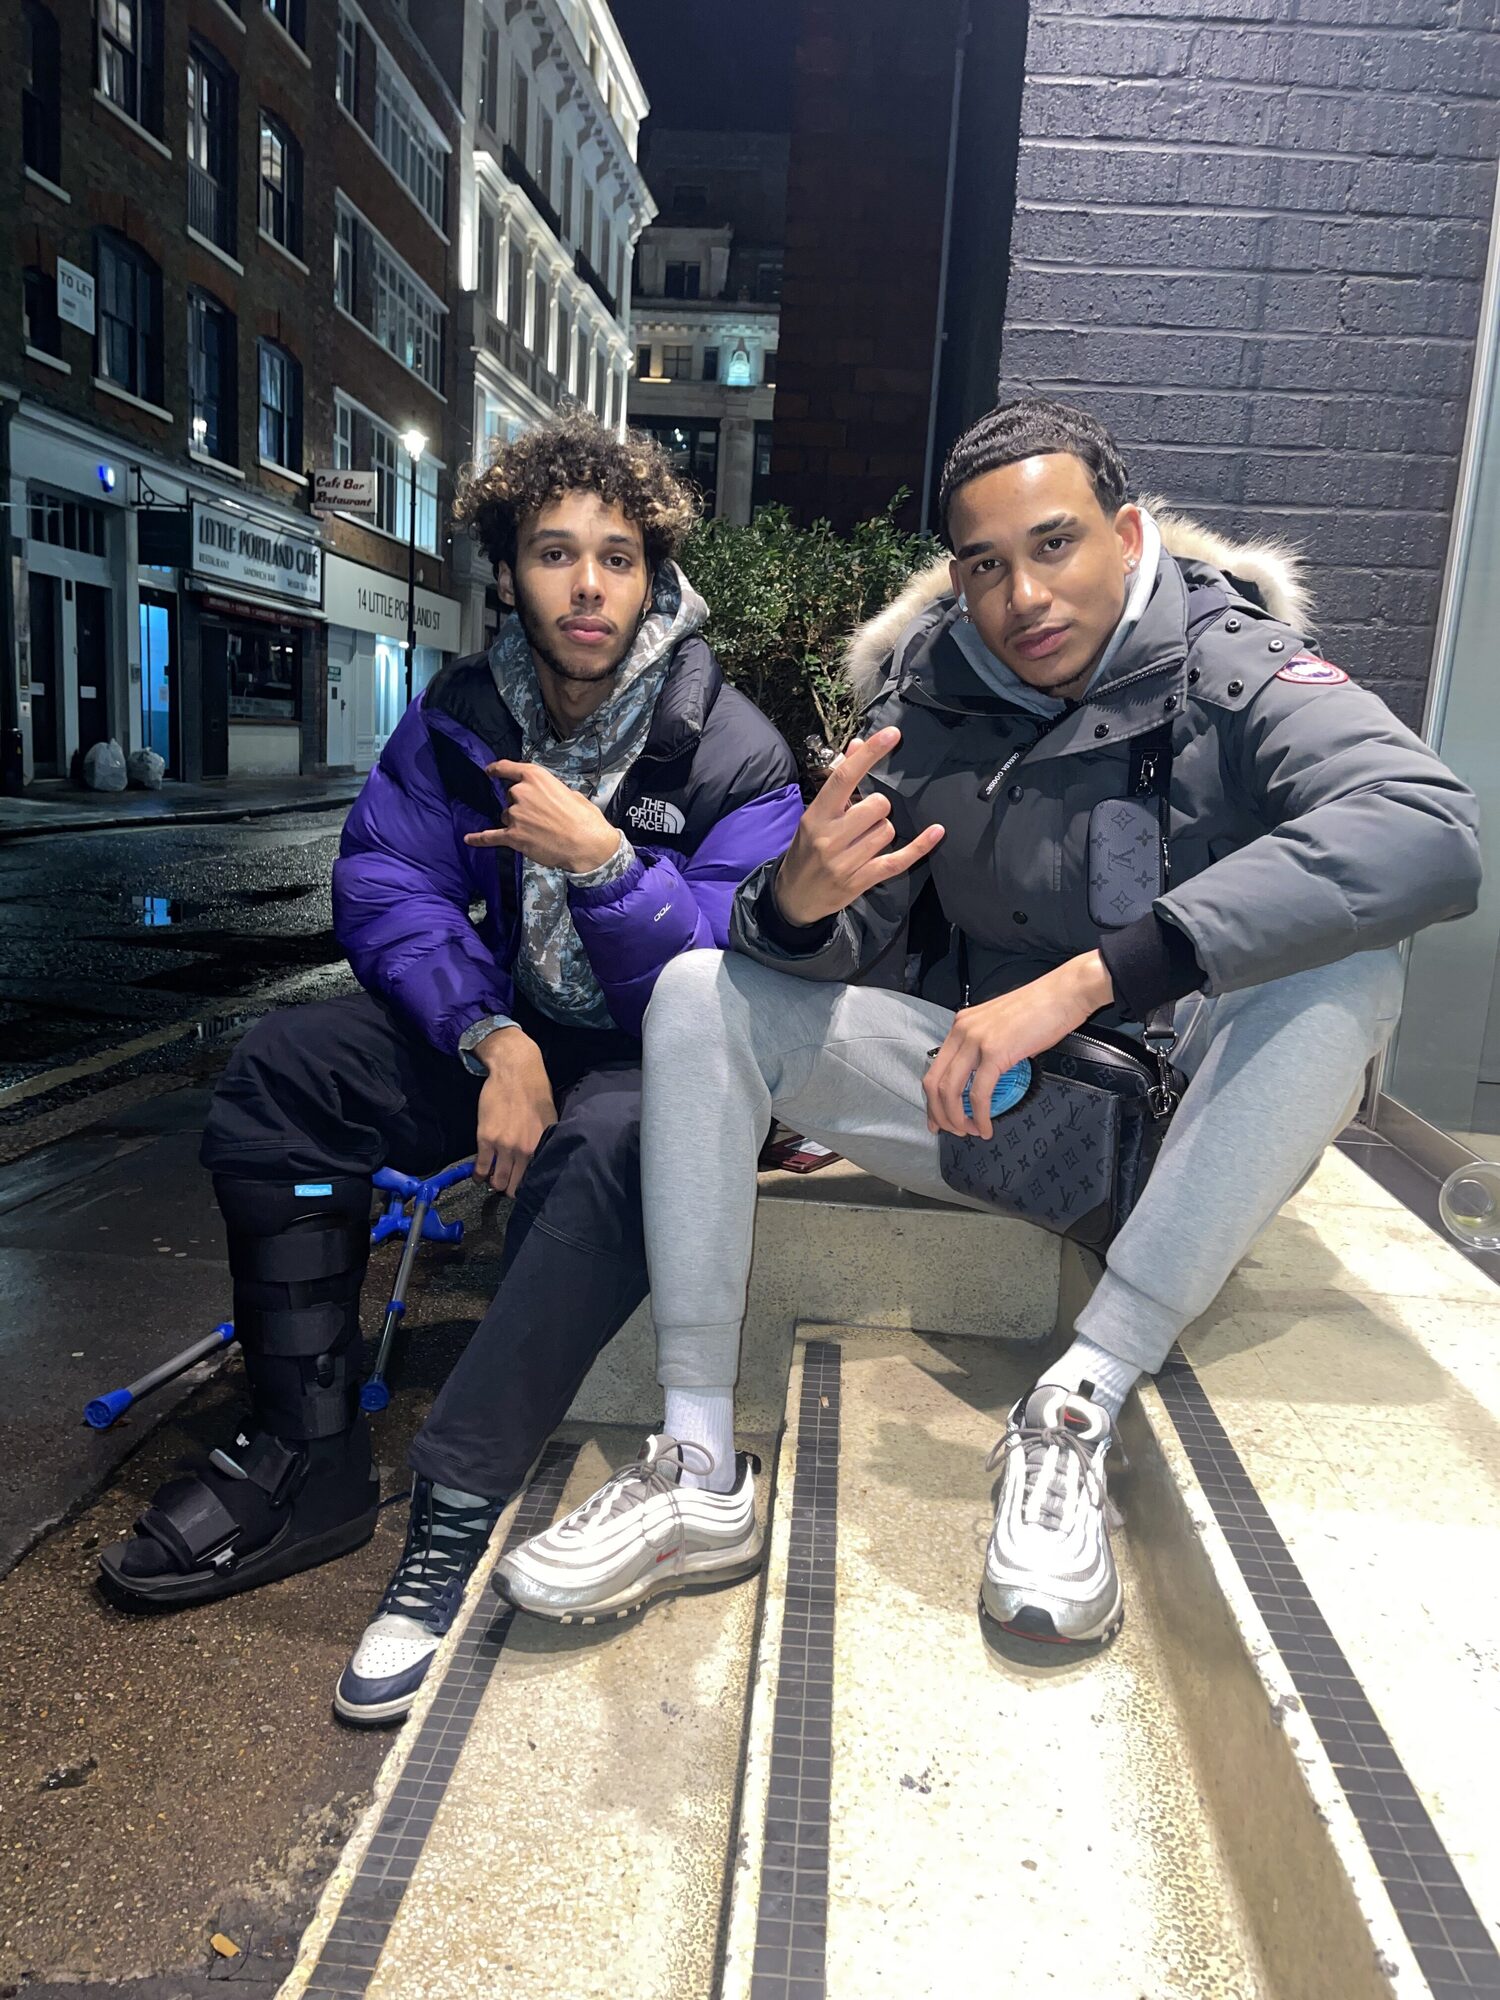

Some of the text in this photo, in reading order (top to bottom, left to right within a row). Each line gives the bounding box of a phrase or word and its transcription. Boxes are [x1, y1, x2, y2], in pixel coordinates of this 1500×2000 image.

[60, 271, 92, 300] TO LET
[343, 478, 365, 490] Bar
[316, 490, 372, 506] Restaurant
[199, 514, 237, 554] LITTLE
[239, 529, 295, 571] PORTLAND
[357, 587, 367, 610] 14
[368, 591, 393, 618] LITTLE
[432, 611, 441, 630] ST
[985, 771, 1004, 795] GOOSE
[641, 796, 666, 813] THE
[626, 805, 664, 824] ORTH
[631, 816, 663, 832] FACE
[653, 902, 672, 922] 700
